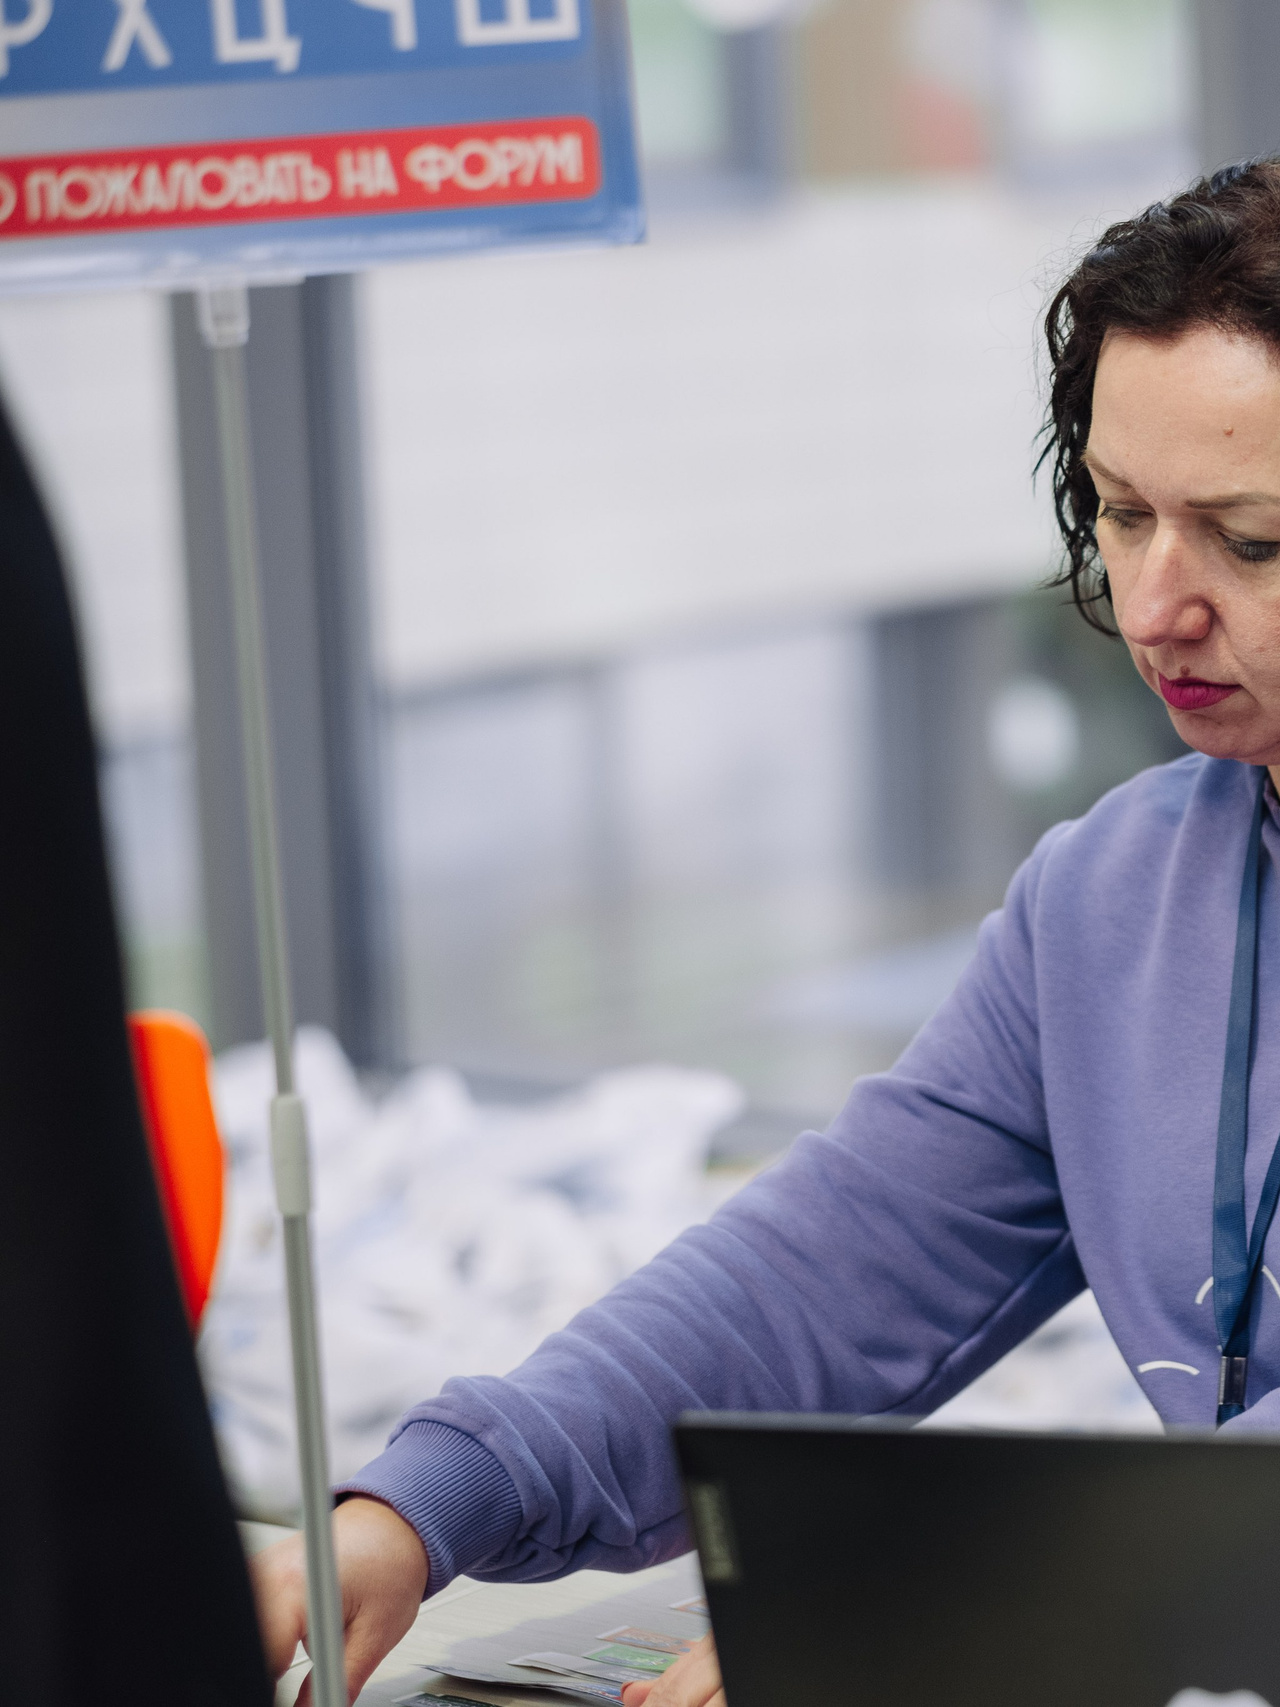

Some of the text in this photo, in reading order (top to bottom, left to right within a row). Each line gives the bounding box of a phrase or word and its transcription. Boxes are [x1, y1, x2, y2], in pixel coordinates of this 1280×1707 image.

[25, 149, 331, 222] ПОЖАЛОВАТЬ
[337, 147, 397, 197] НА
[405, 133, 584, 193] ФОРУМ
